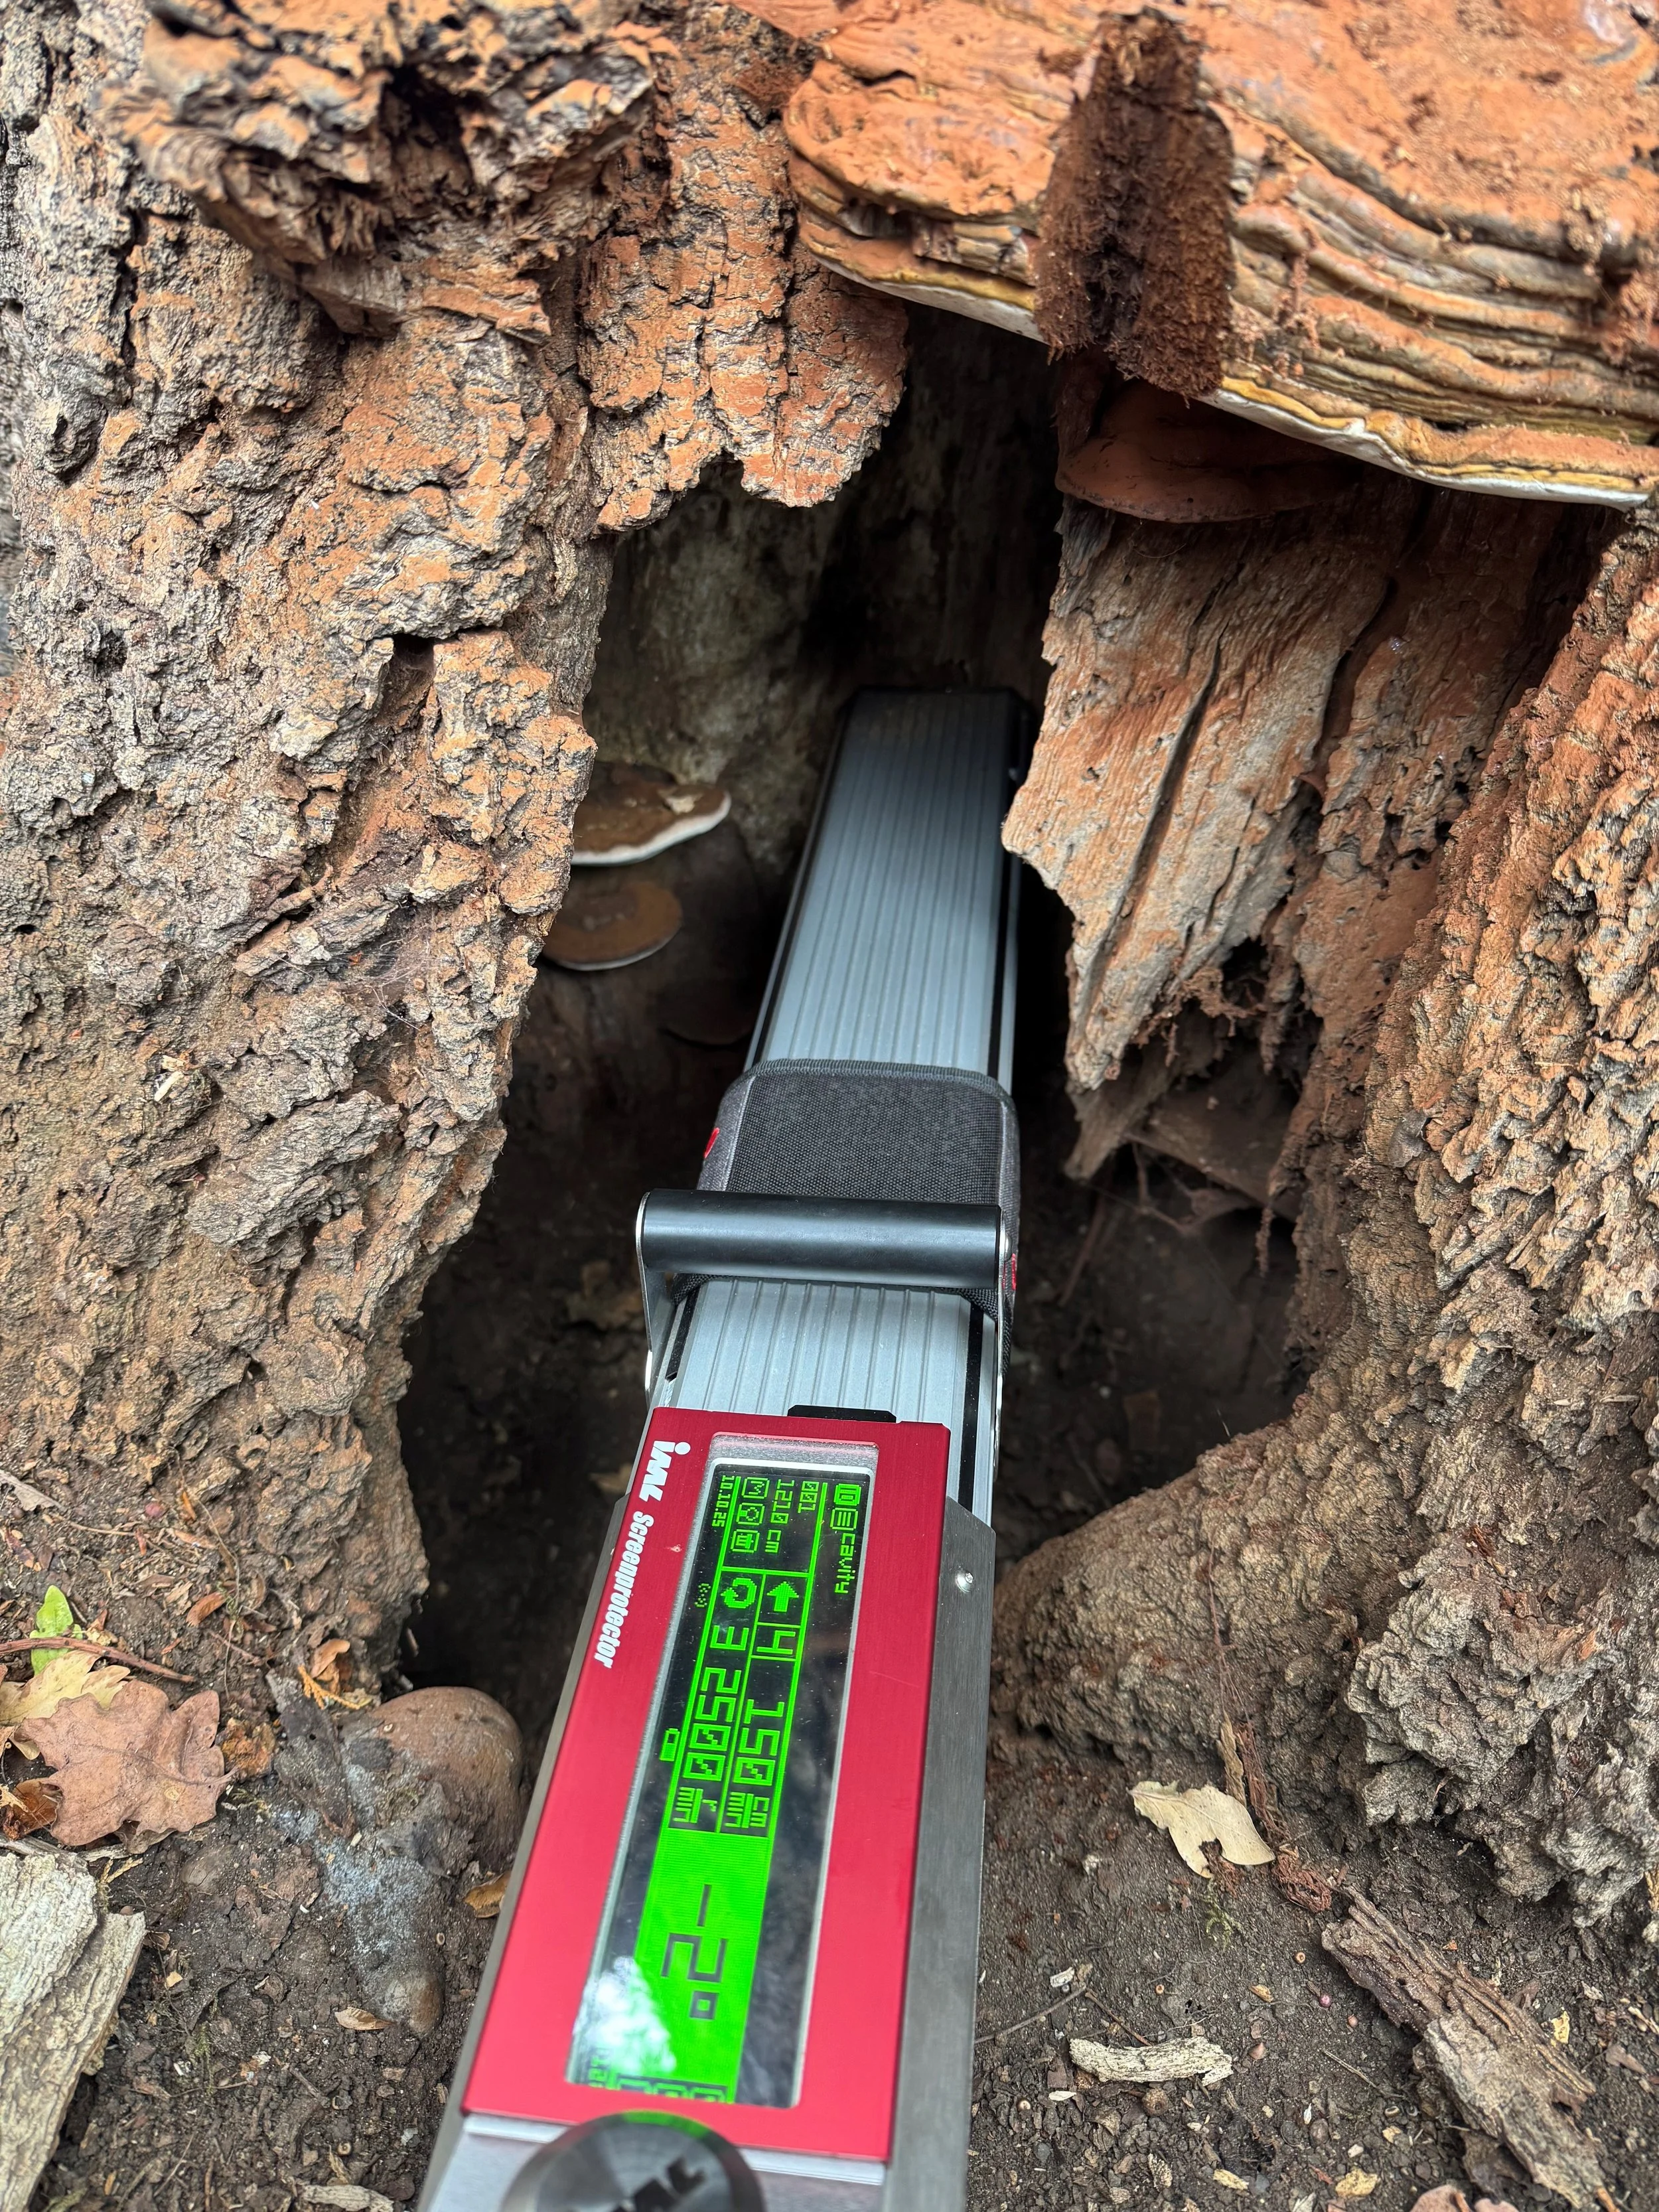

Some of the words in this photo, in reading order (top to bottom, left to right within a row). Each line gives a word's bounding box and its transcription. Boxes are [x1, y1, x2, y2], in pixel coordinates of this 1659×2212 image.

[712, 1475, 735, 1527] 10.10.25
[770, 1479, 795, 1524] 1210
[798, 1481, 819, 1513] 001
[764, 1529, 781, 1553] cm
[835, 1533, 856, 1593] cavity
[594, 1511, 654, 1668] Screenprotector
[709, 1625, 749, 1651] 3
[757, 1630, 796, 1655] 4
[682, 1667, 741, 1781] 2500
[732, 1699, 784, 1787] 150
[673, 1787, 695, 1822] min
[725, 1792, 746, 1828] min
[750, 1797, 770, 1827] cm
